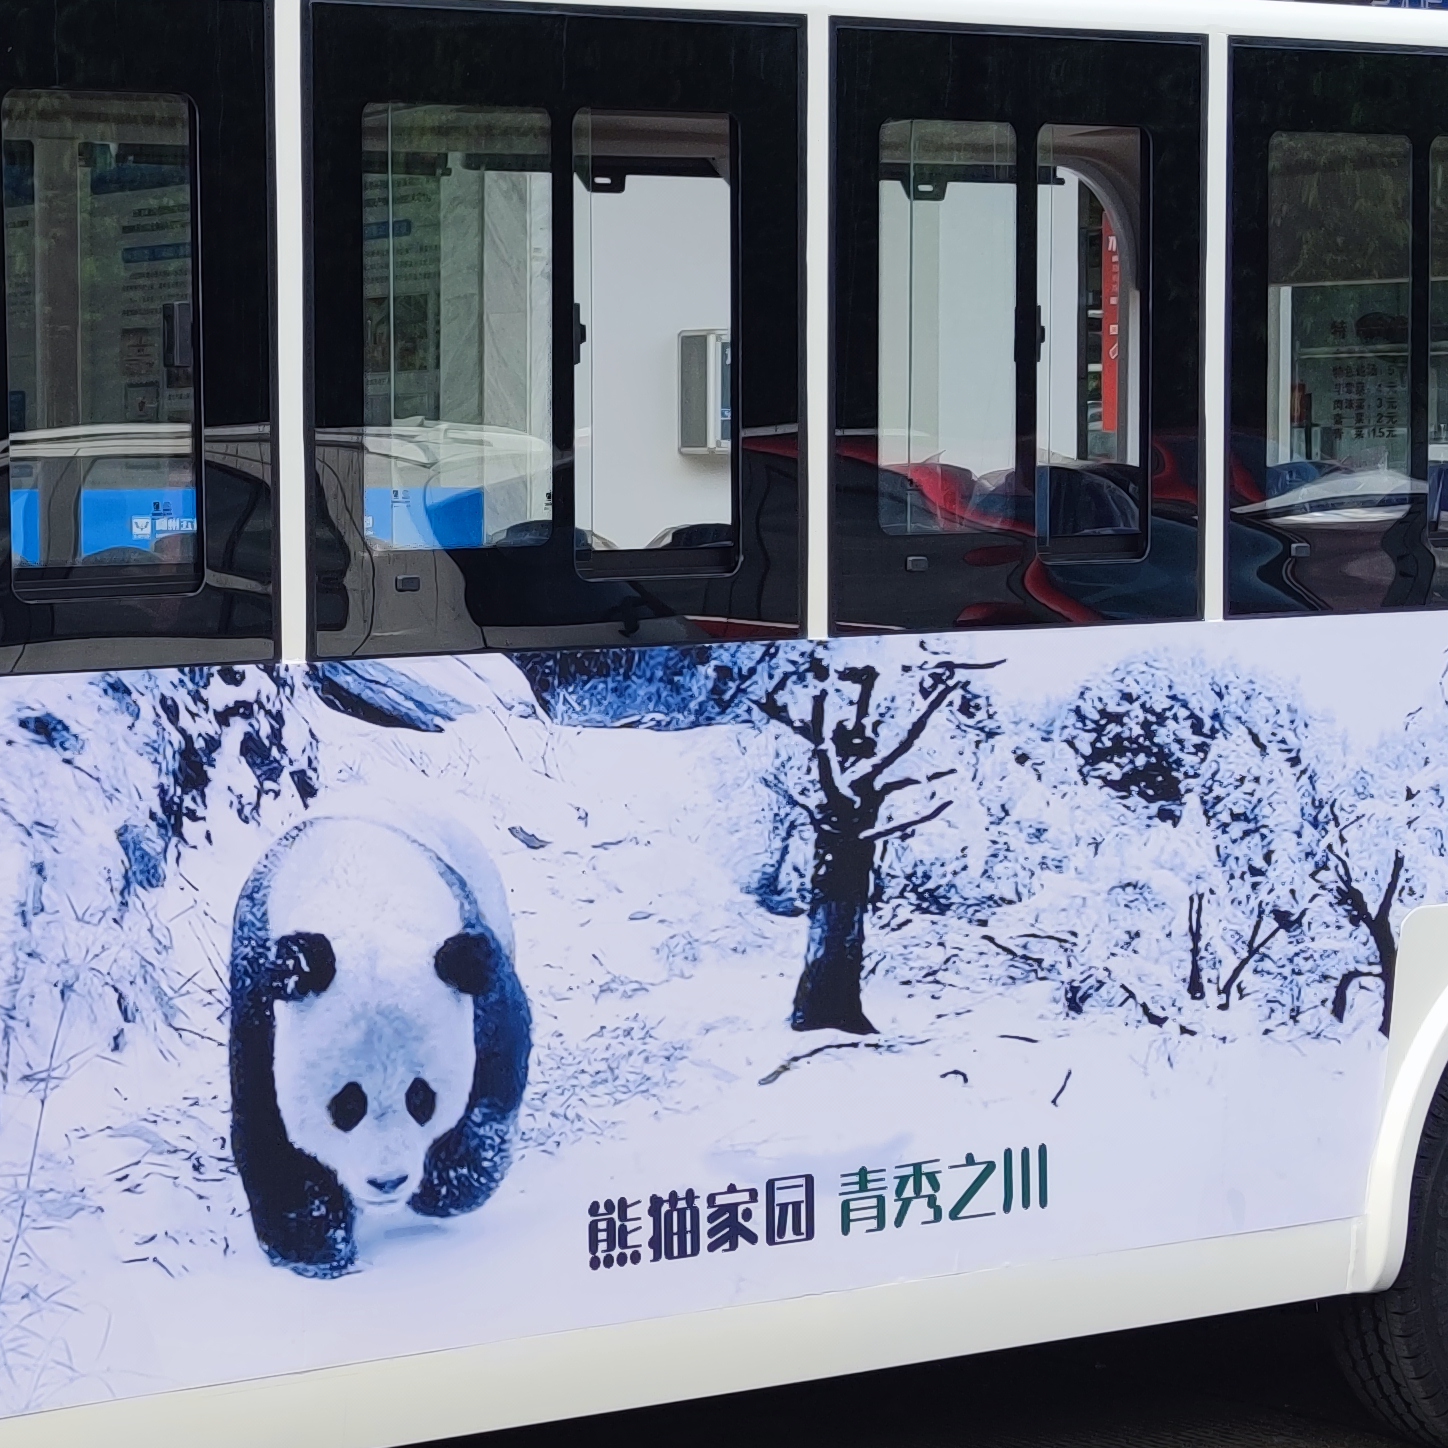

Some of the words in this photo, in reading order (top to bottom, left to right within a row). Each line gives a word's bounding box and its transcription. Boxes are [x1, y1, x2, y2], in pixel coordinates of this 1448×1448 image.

[587, 1174, 816, 1271] 熊猫家园
[838, 1142, 1049, 1237] 青秀之川
